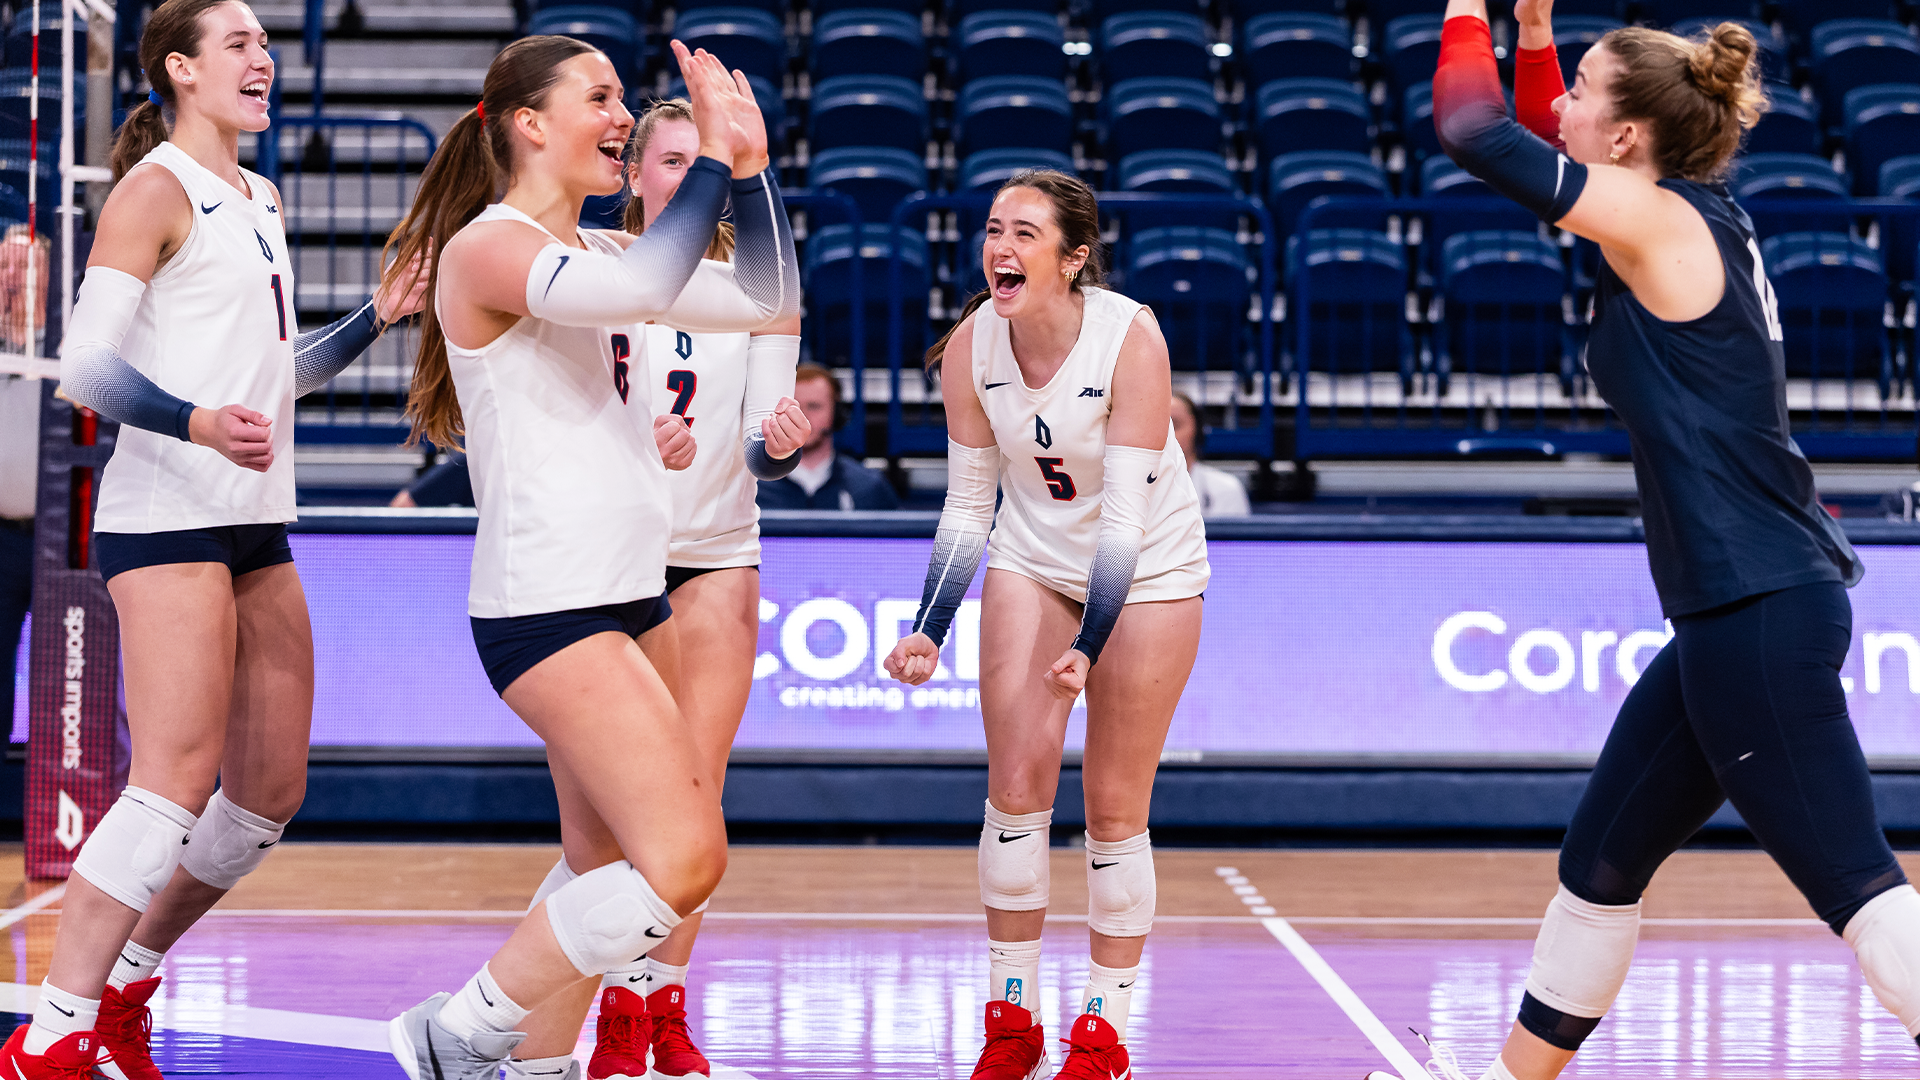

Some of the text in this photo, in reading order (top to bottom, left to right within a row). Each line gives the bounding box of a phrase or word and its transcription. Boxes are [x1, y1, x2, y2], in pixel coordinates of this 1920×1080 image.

[271, 274, 287, 341] 1
[611, 333, 630, 405] 6
[667, 369, 697, 428] 2
[1034, 456, 1077, 501] 5
[61, 606, 86, 770] sports imports
[779, 684, 905, 711] creating
